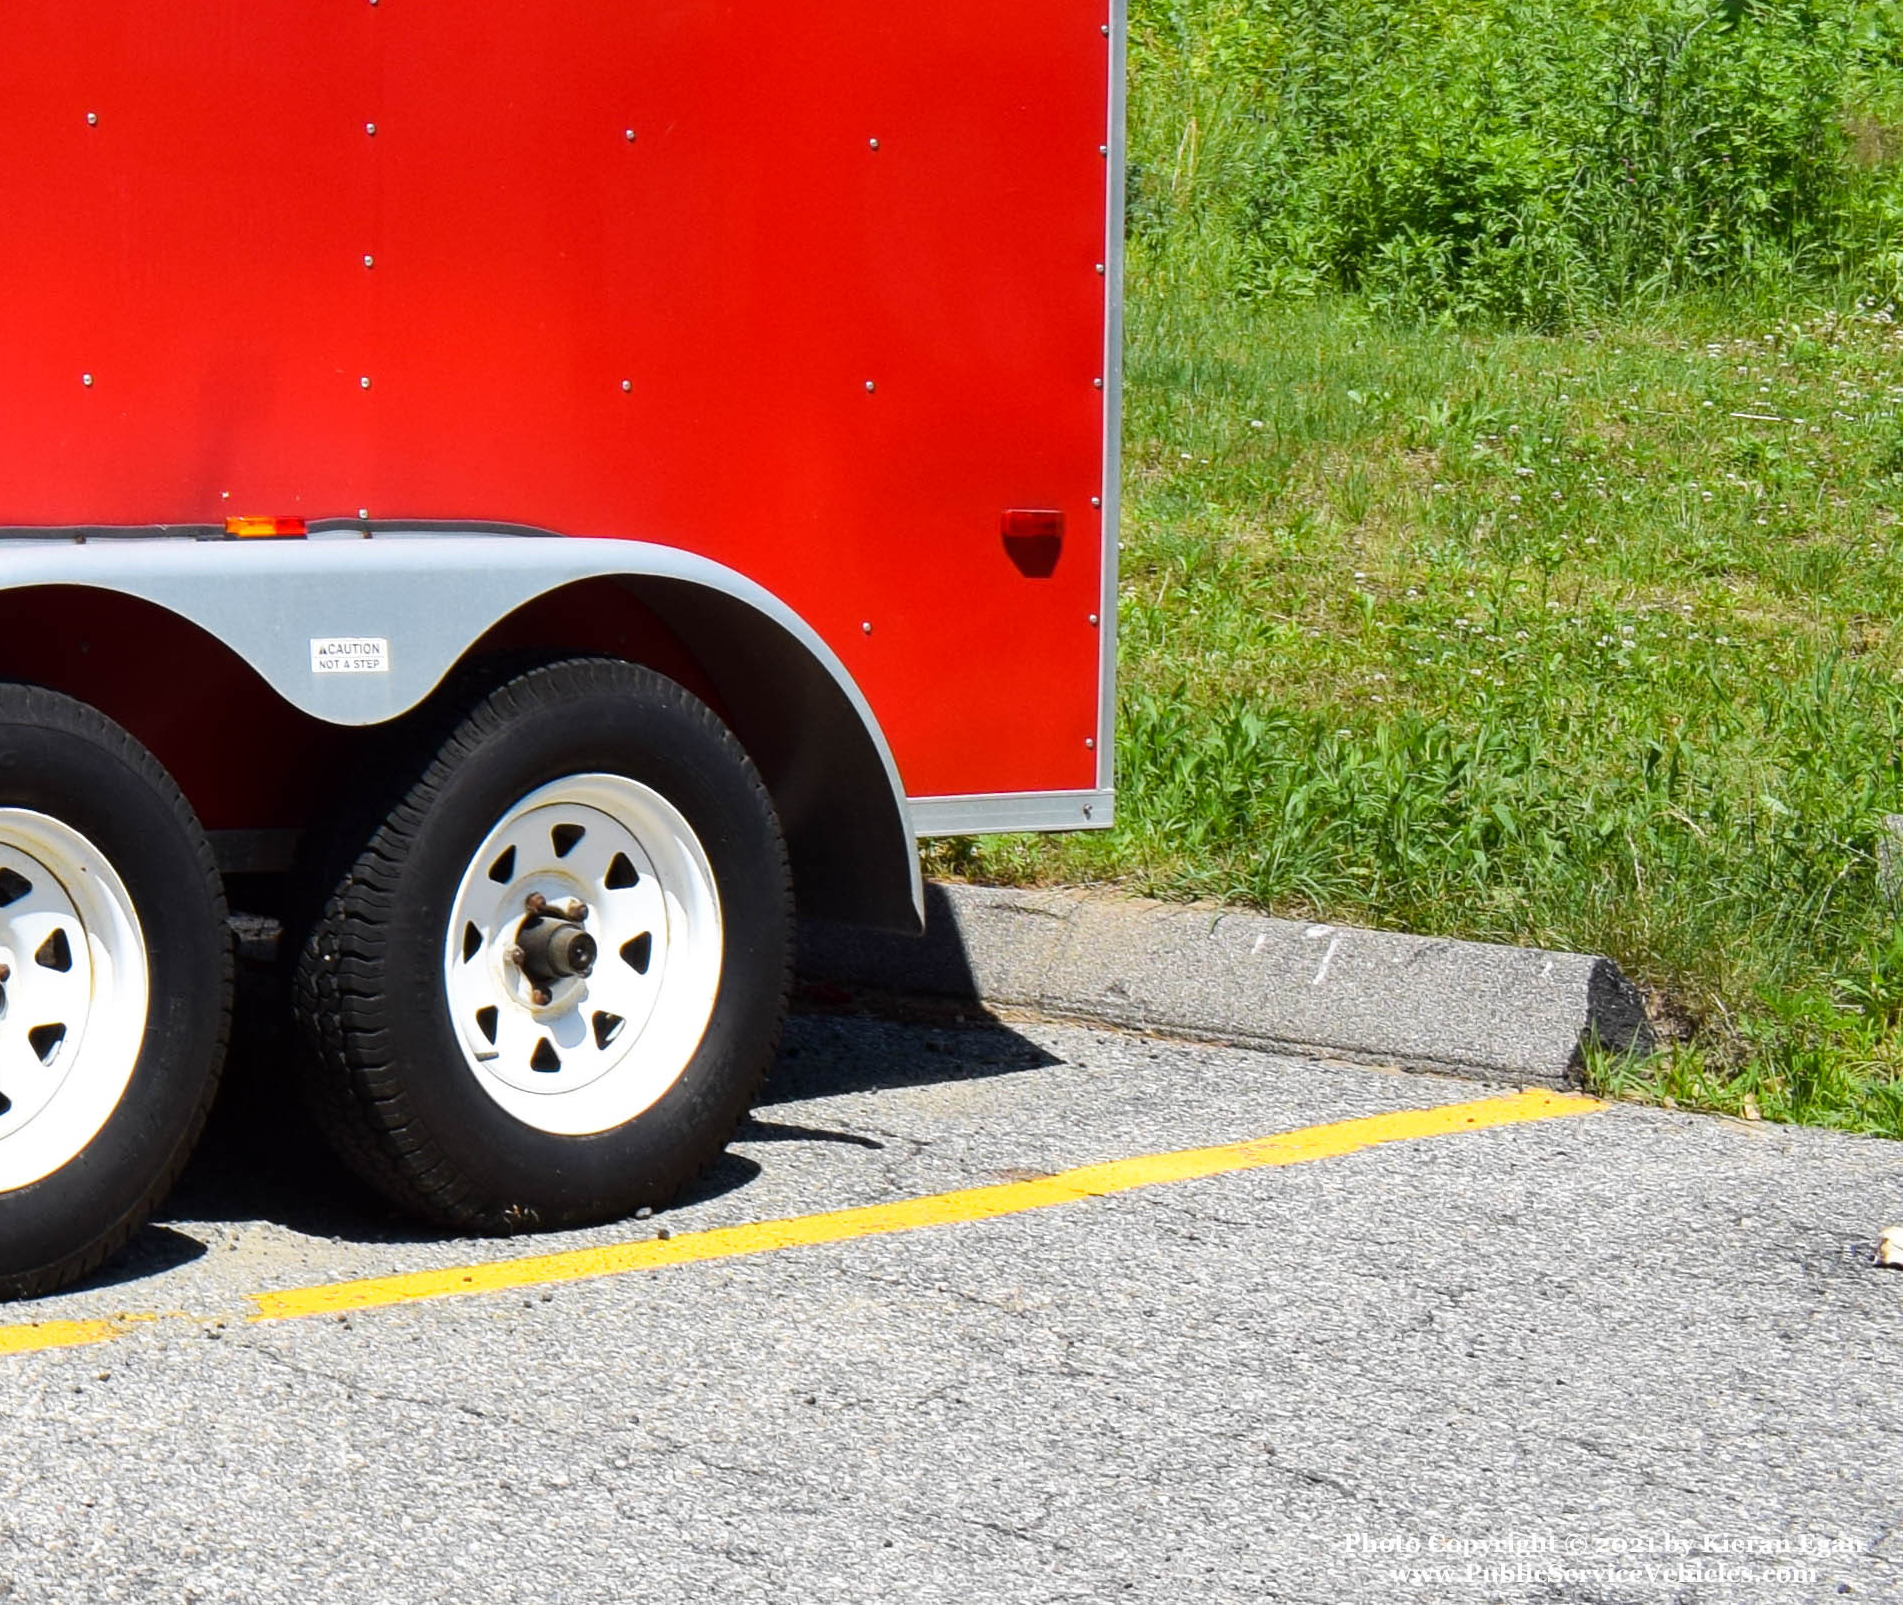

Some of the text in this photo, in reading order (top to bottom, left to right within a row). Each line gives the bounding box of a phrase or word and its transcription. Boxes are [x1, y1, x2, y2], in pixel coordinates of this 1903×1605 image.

[328, 643, 380, 655] CAUTION
[319, 659, 380, 669] NOT A STEP
